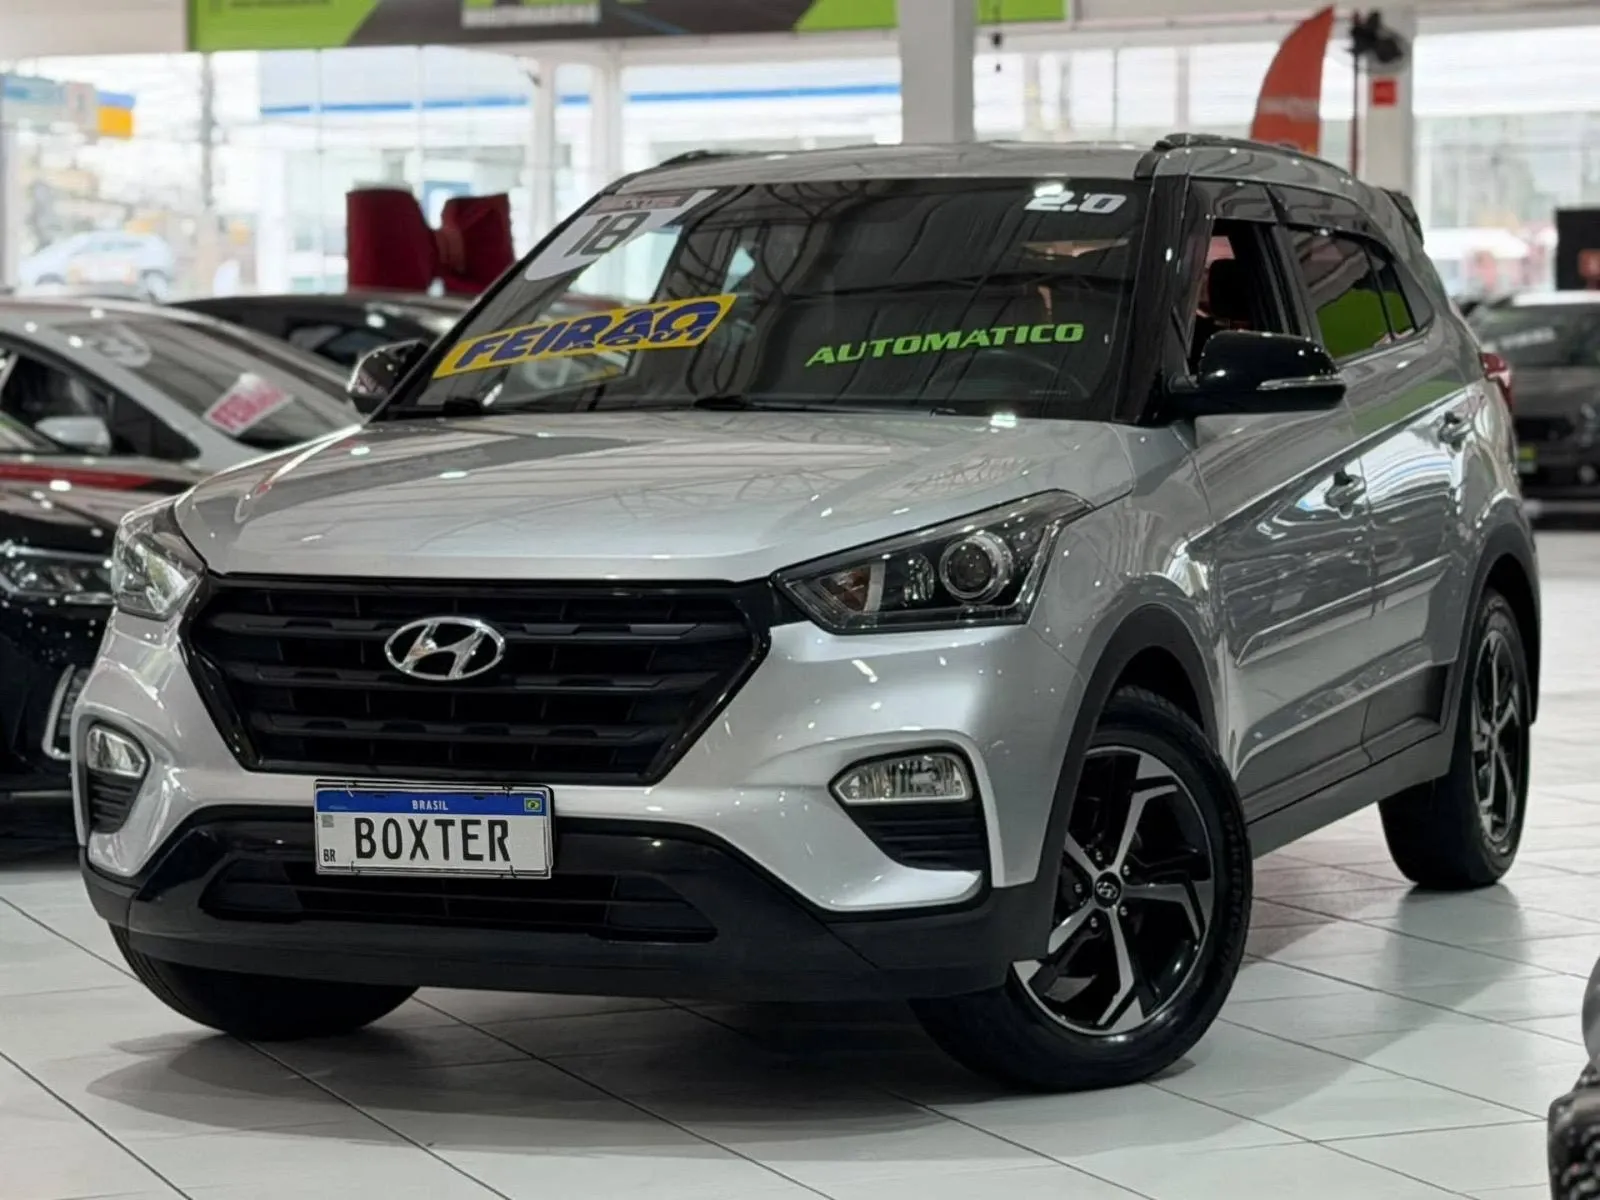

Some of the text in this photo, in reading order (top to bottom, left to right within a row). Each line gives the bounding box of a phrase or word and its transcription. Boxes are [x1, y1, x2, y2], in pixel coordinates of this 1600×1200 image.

[1024, 187, 1127, 214] 2.0
[563, 211, 651, 257] 18
[453, 301, 721, 368] FEIRÃO
[805, 323, 1084, 367] AUTOMATICO
[411, 799, 449, 811] BRASIL
[323, 848, 336, 862] BR
[354, 817, 511, 862] BOXTER
